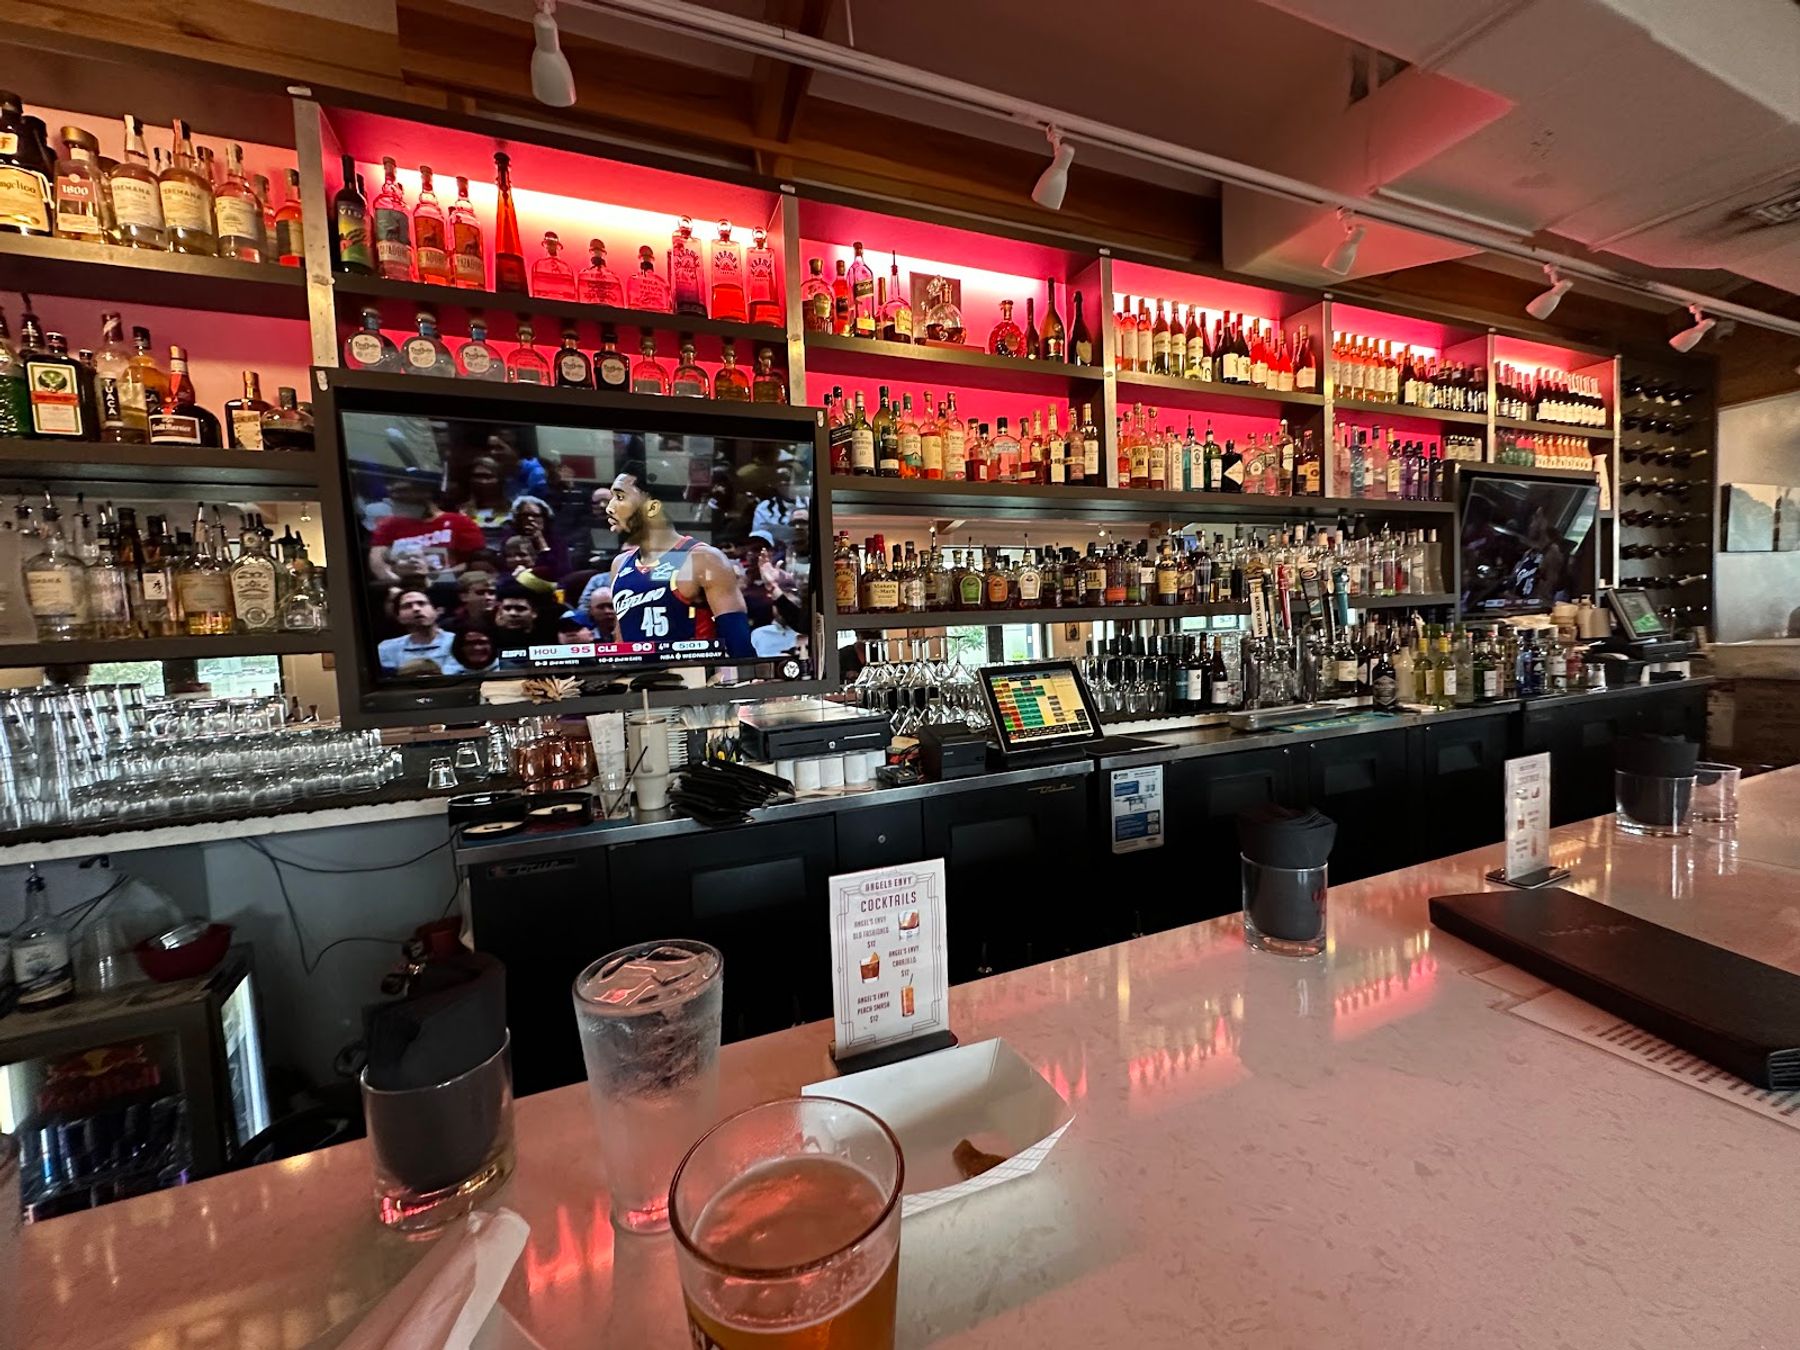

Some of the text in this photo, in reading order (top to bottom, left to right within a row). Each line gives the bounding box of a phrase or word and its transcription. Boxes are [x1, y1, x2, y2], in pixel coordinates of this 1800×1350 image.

[62, 184, 88, 195] 1800
[103, 379, 118, 416] TUACA
[641, 606, 669, 637] 45
[534, 648, 557, 656] HOU
[570, 646, 591, 654] 95
[597, 645, 617, 653] CLE
[679, 641, 702, 649] 5:01
[860, 891, 917, 913] COCKTAILS
